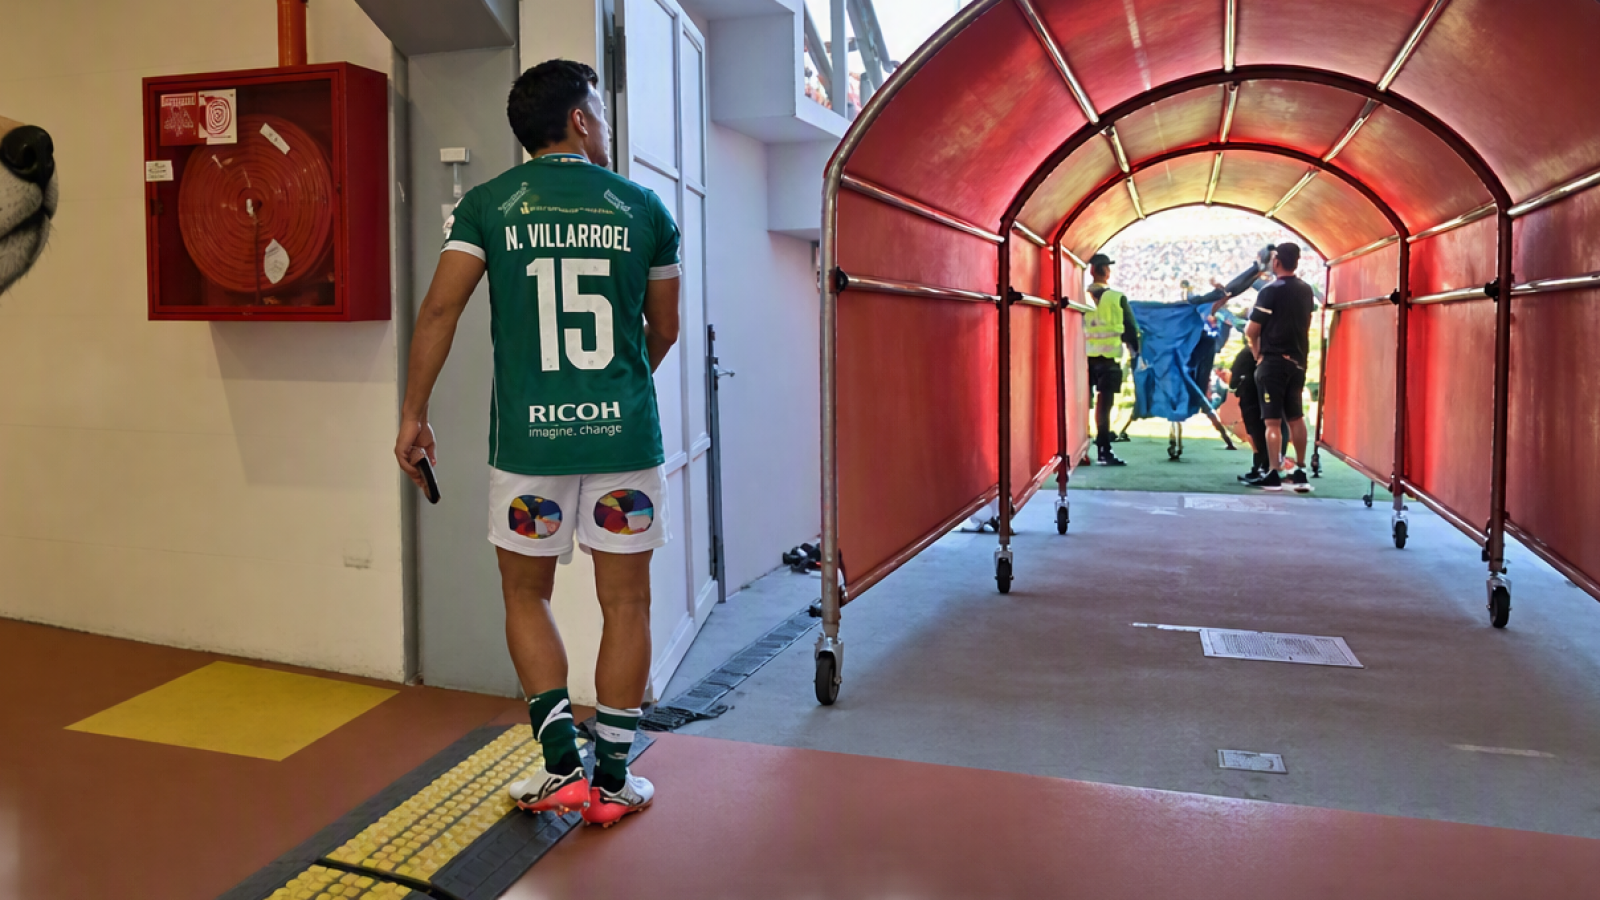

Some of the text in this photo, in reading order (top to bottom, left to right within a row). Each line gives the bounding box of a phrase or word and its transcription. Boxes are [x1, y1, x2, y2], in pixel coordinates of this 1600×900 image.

[505, 223, 632, 252] N. VILLARROEL
[526, 257, 614, 371] 15
[529, 401, 621, 423] RICOH
[529, 424, 622, 439] imagine. change
